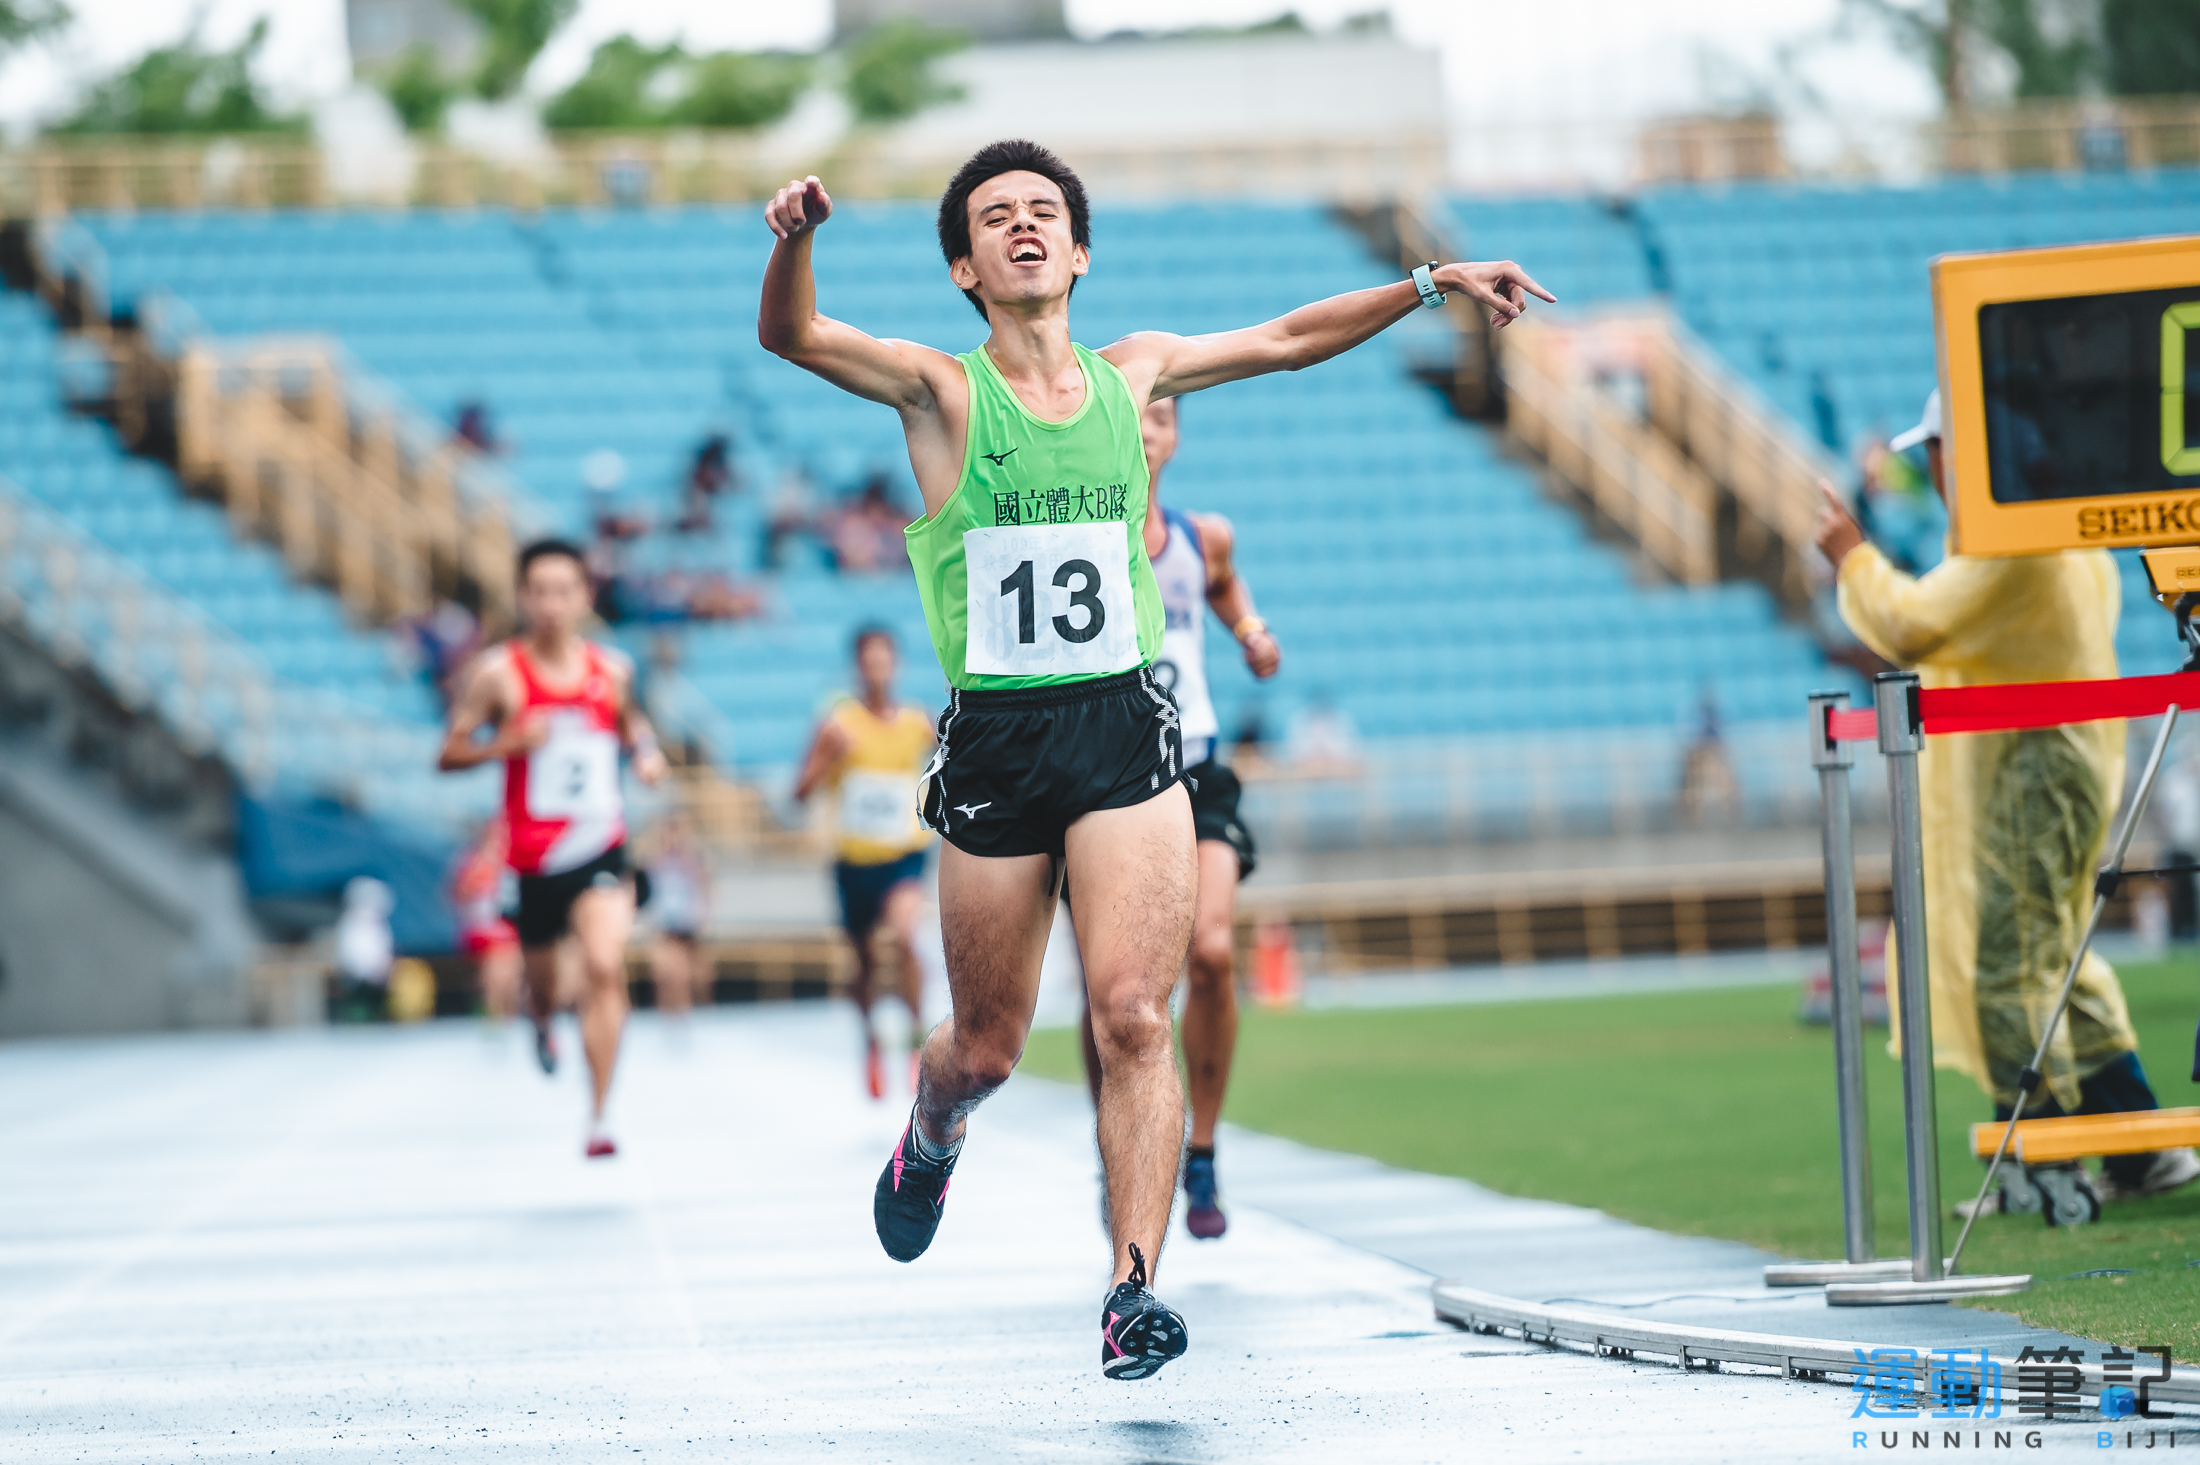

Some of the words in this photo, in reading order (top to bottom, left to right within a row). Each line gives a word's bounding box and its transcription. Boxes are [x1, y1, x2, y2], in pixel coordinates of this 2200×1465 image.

[994, 483, 1128, 526] 國立體大B隊
[1001, 559, 1105, 644] 13
